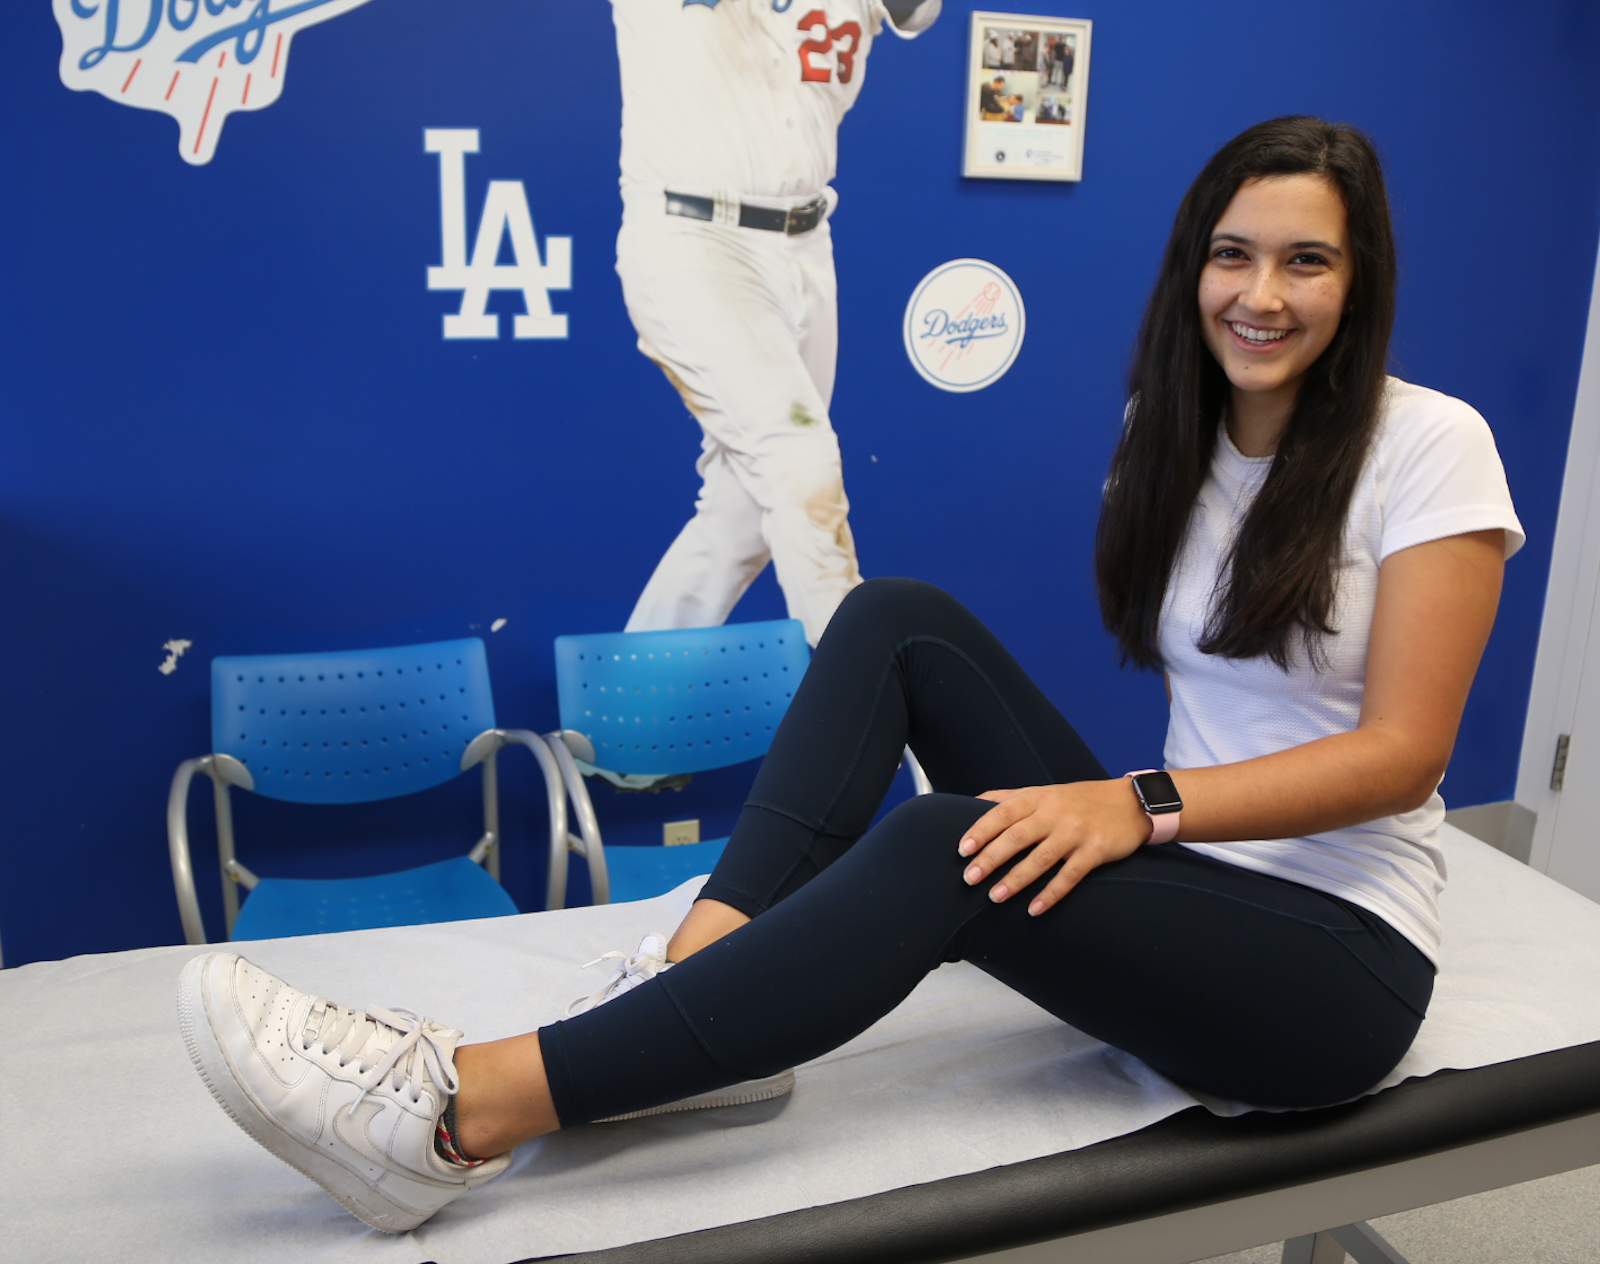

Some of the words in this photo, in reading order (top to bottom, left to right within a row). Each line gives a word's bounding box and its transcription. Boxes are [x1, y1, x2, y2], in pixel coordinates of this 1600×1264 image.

[797, 9, 861, 84] 23
[424, 127, 572, 340] LA
[919, 308, 1009, 349] Dodgers
